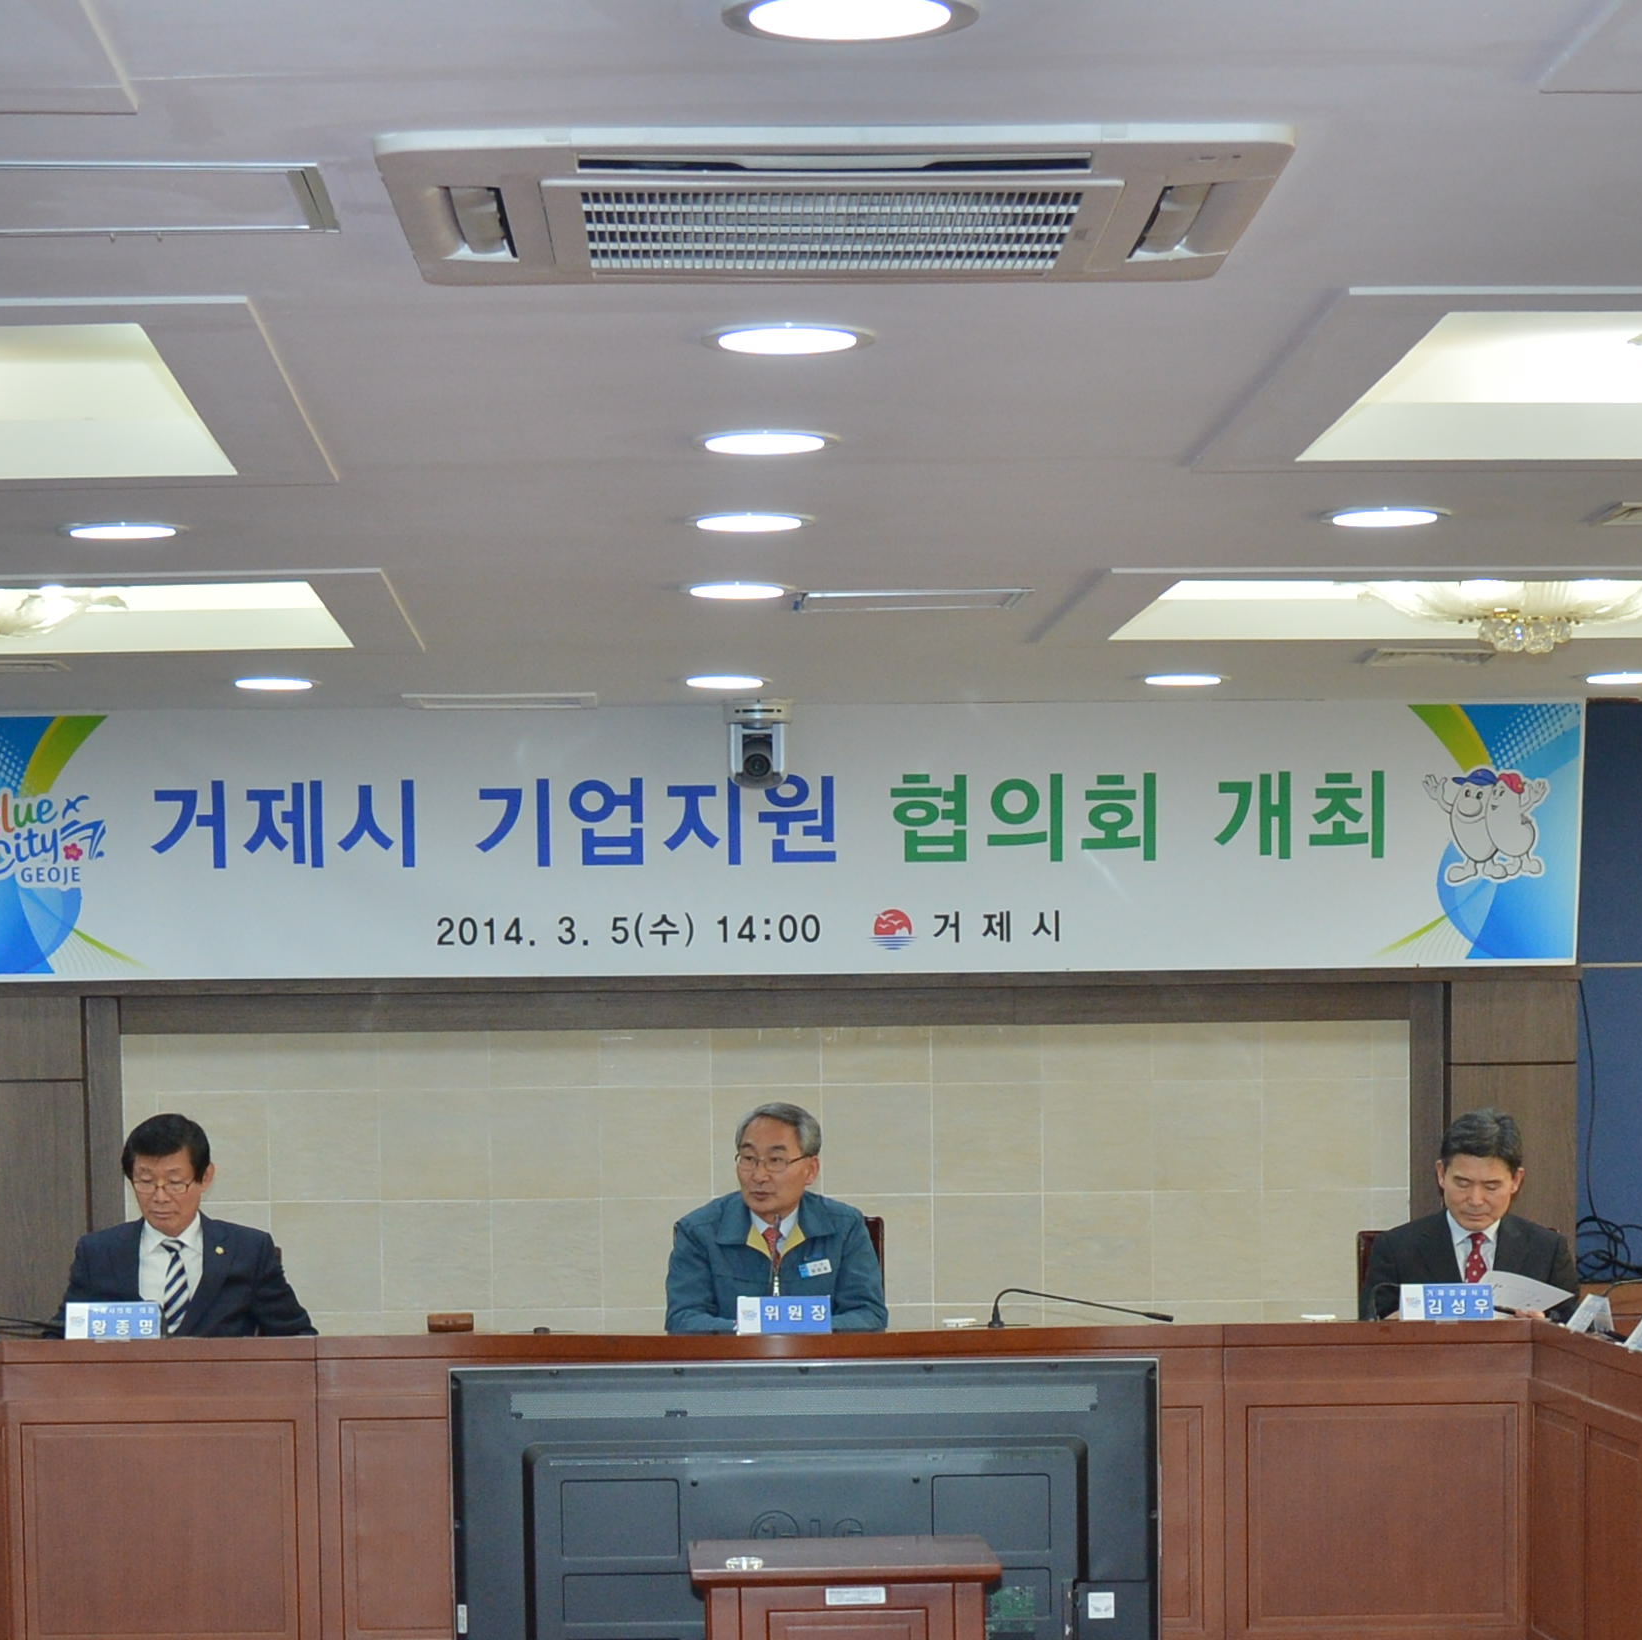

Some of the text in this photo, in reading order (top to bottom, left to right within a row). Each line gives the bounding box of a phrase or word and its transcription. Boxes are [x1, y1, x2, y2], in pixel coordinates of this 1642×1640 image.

[151, 770, 1385, 869] 거제시 기업지원 협의회 개최
[20, 866, 81, 885] GEOJE
[437, 912, 821, 947] 2014. 3. 5(수) 14:00
[932, 910, 1060, 943] 거제시
[764, 1304, 827, 1321] 위원장
[1428, 1299, 1490, 1314] 김성우
